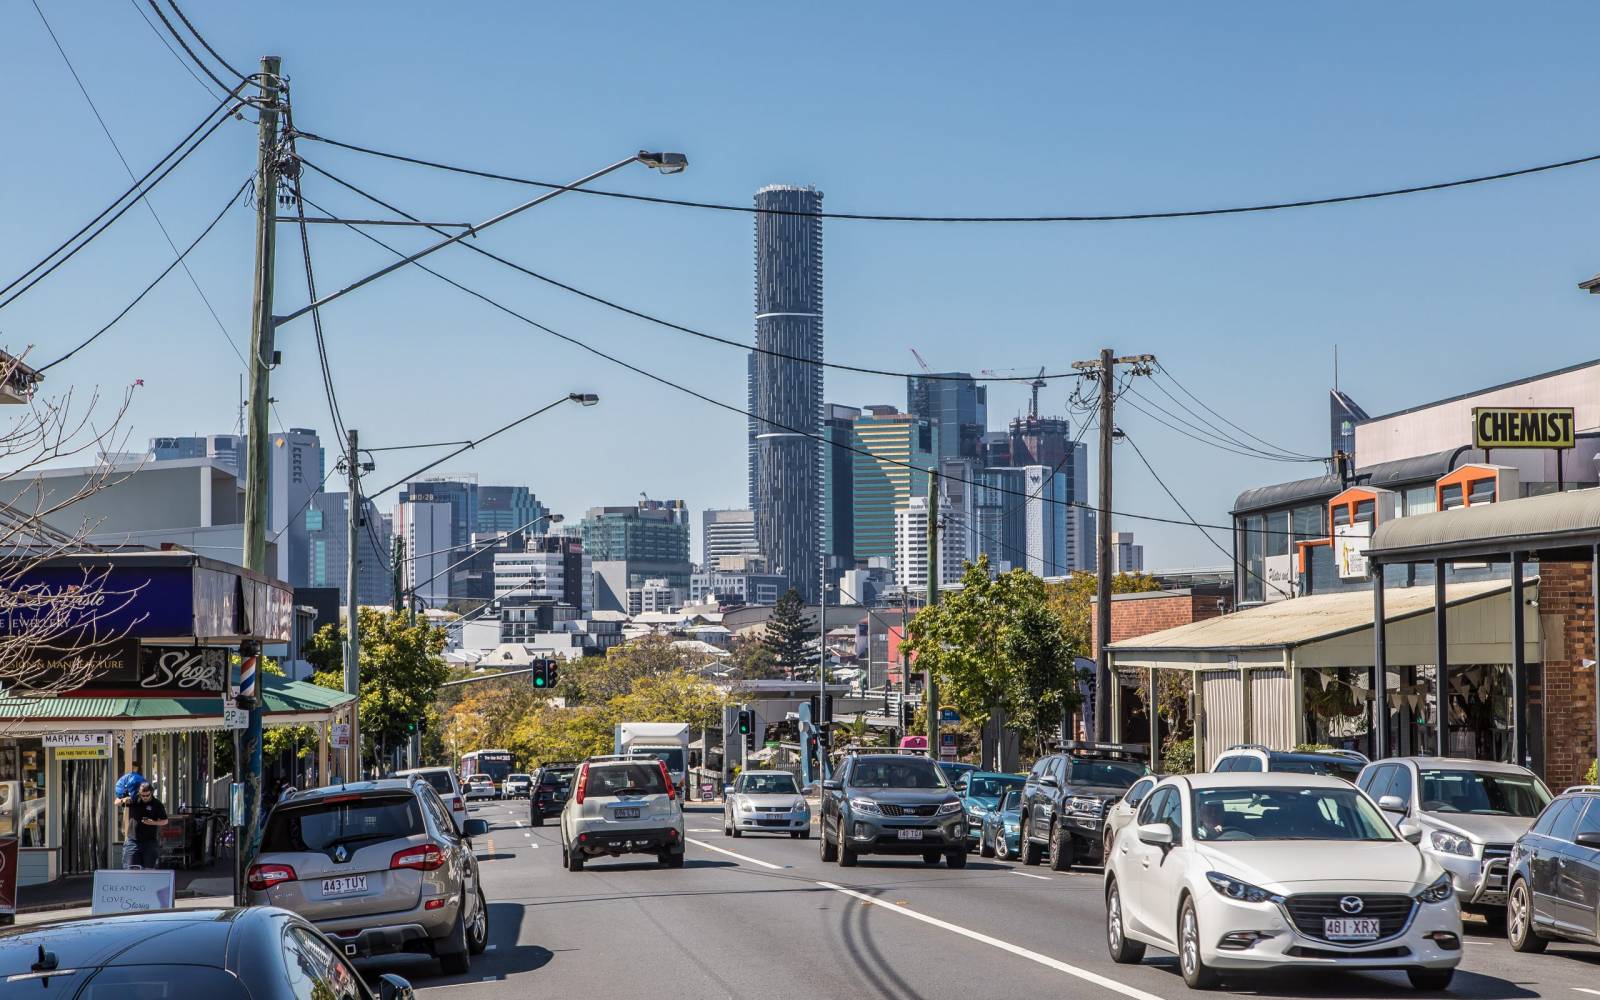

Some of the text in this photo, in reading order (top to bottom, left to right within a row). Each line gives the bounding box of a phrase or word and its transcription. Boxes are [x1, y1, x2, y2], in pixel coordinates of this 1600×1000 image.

[1479, 412, 1571, 442] CHEMIST
[140, 649, 216, 689] Shop
[225, 710, 236, 721] 2P
[45, 734, 94, 743] MARTHA ST
[102, 884, 146, 892] CREATING
[102, 895, 123, 903] LOVE
